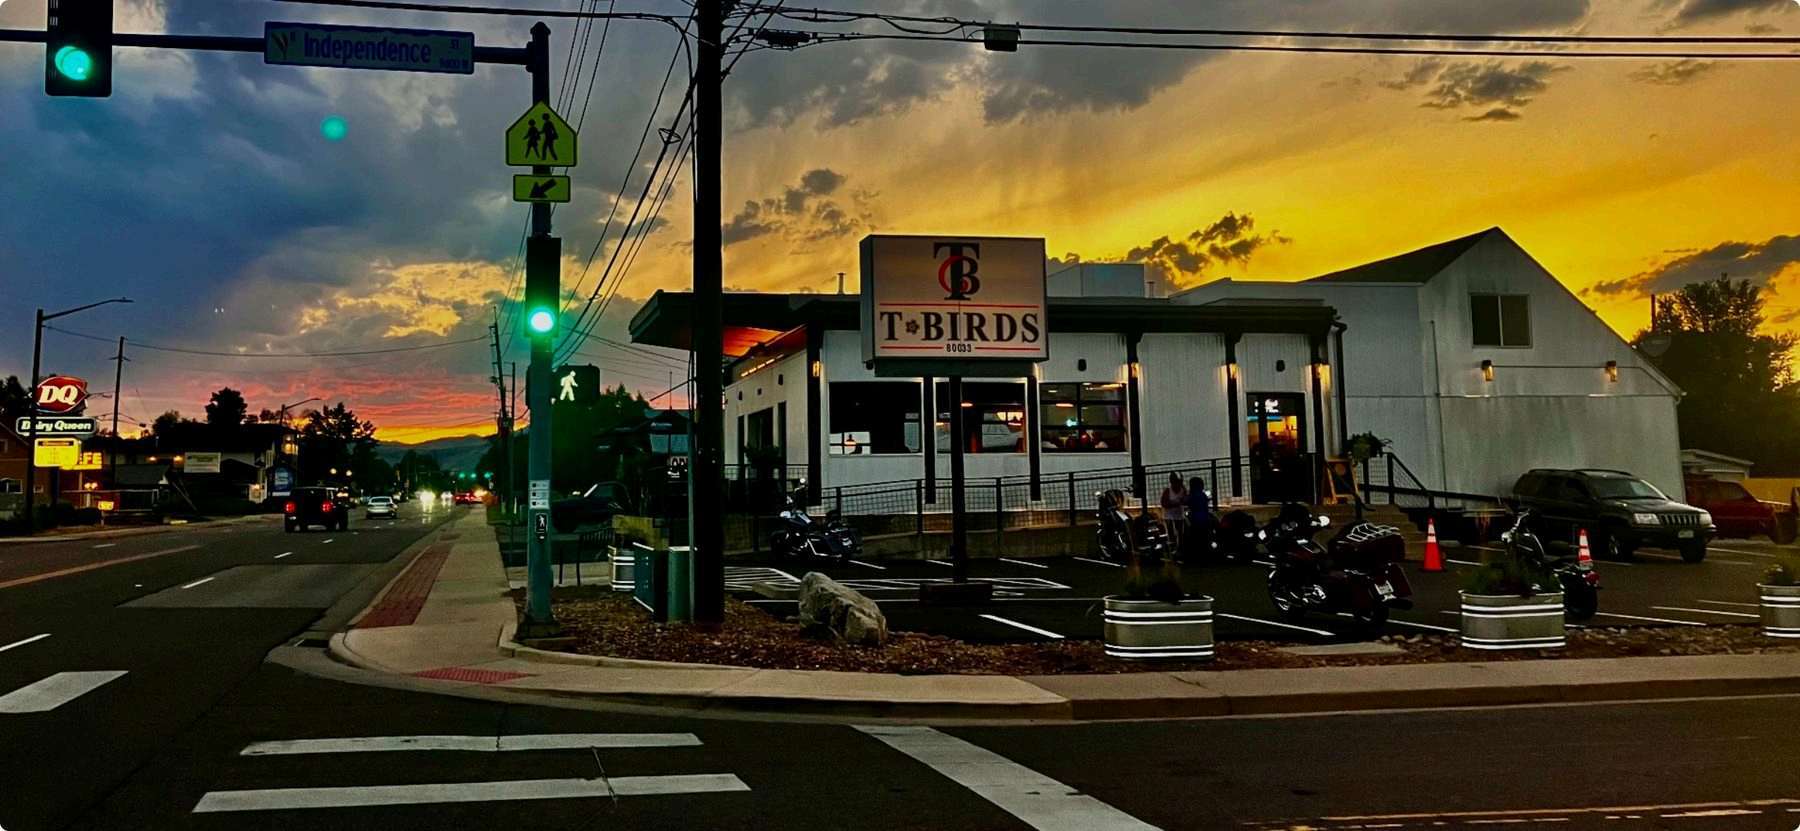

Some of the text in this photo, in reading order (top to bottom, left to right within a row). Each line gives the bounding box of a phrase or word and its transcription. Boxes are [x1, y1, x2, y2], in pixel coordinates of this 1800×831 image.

[304, 31, 432, 64] Independence
[946, 343, 972, 353] 80033
[39, 385, 78, 405] DQ
[21, 420, 91, 431] Diry Queen
